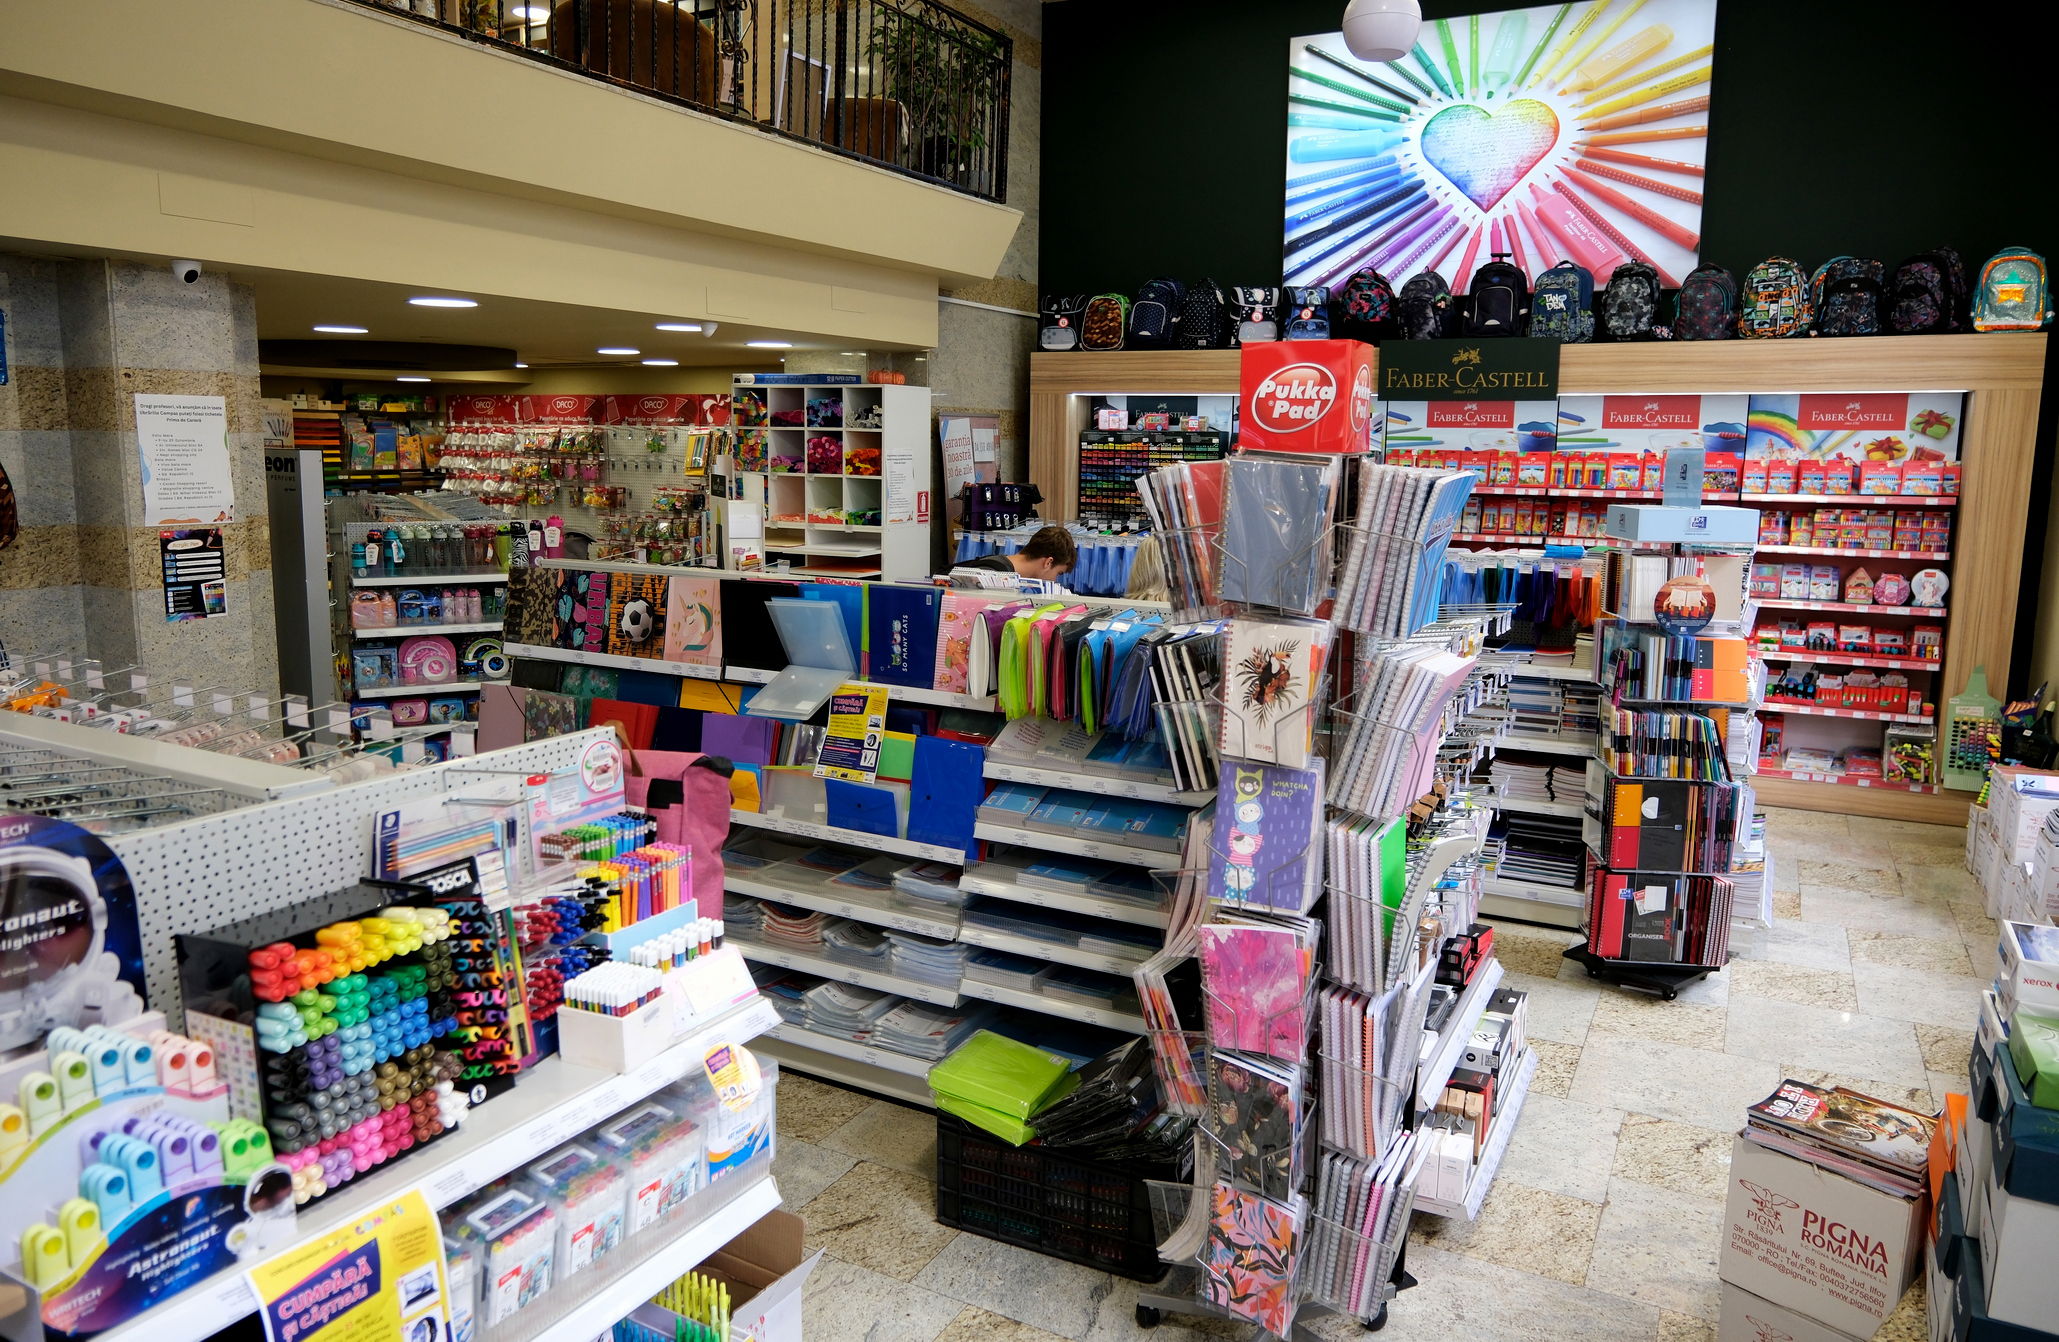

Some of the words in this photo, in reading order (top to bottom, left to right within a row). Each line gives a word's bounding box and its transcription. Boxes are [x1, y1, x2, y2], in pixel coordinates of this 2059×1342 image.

[1573, 218, 1607, 254] FABER-CASTELL
[1386, 366, 1549, 388] FABER-CASTELL
[1258, 379, 1337, 400] Pukka
[475, 401, 492, 409] DACO
[556, 400, 575, 409] DACO
[644, 400, 664, 409] DACO
[1272, 400, 1321, 420] Pad
[1433, 412, 1508, 422] FABER-CASTELL
[1609, 411, 1693, 423] FABER-CASTELL
[1811, 410, 1895, 422] FABER-CASTELL
[946, 449, 972, 463] noastră
[947, 468, 954, 478] 30
[954, 466, 962, 477] de
[962, 464, 973, 475] zile
[902, 662, 908, 672] SO
[1272, 780, 1309, 791] WHATCHA
[1627, 932, 1664, 941] ORGANISER
[2023, 976, 2053, 989] xerox
[1746, 1209, 1784, 1235] PIGNA
[1756, 1223, 1773, 1236] 1839
[1803, 1209, 1889, 1265] PIGNA
[127, 1223, 221, 1279] Astronaut
[1732, 1233, 1760, 1251] 070000
[1766, 1249, 1779, 1260] RO
[1801, 1228, 1888, 1279] ROMANIA
[1733, 1224, 1746, 1235] Str.
[1791, 1250, 1802, 1262] Nr.
[1850, 1278, 1867, 1291] Jud.
[1870, 1286, 1887, 1299] Ilfov
[278, 1255, 373, 1320] CUMPĂRĂ
[1731, 1241, 1754, 1257] Email:
[1758, 1255, 1817, 1287] office@pigna.ro
[1828, 1288, 1883, 1319] www.pigna.ro
[48, 1285, 101, 1317] WRITECH
